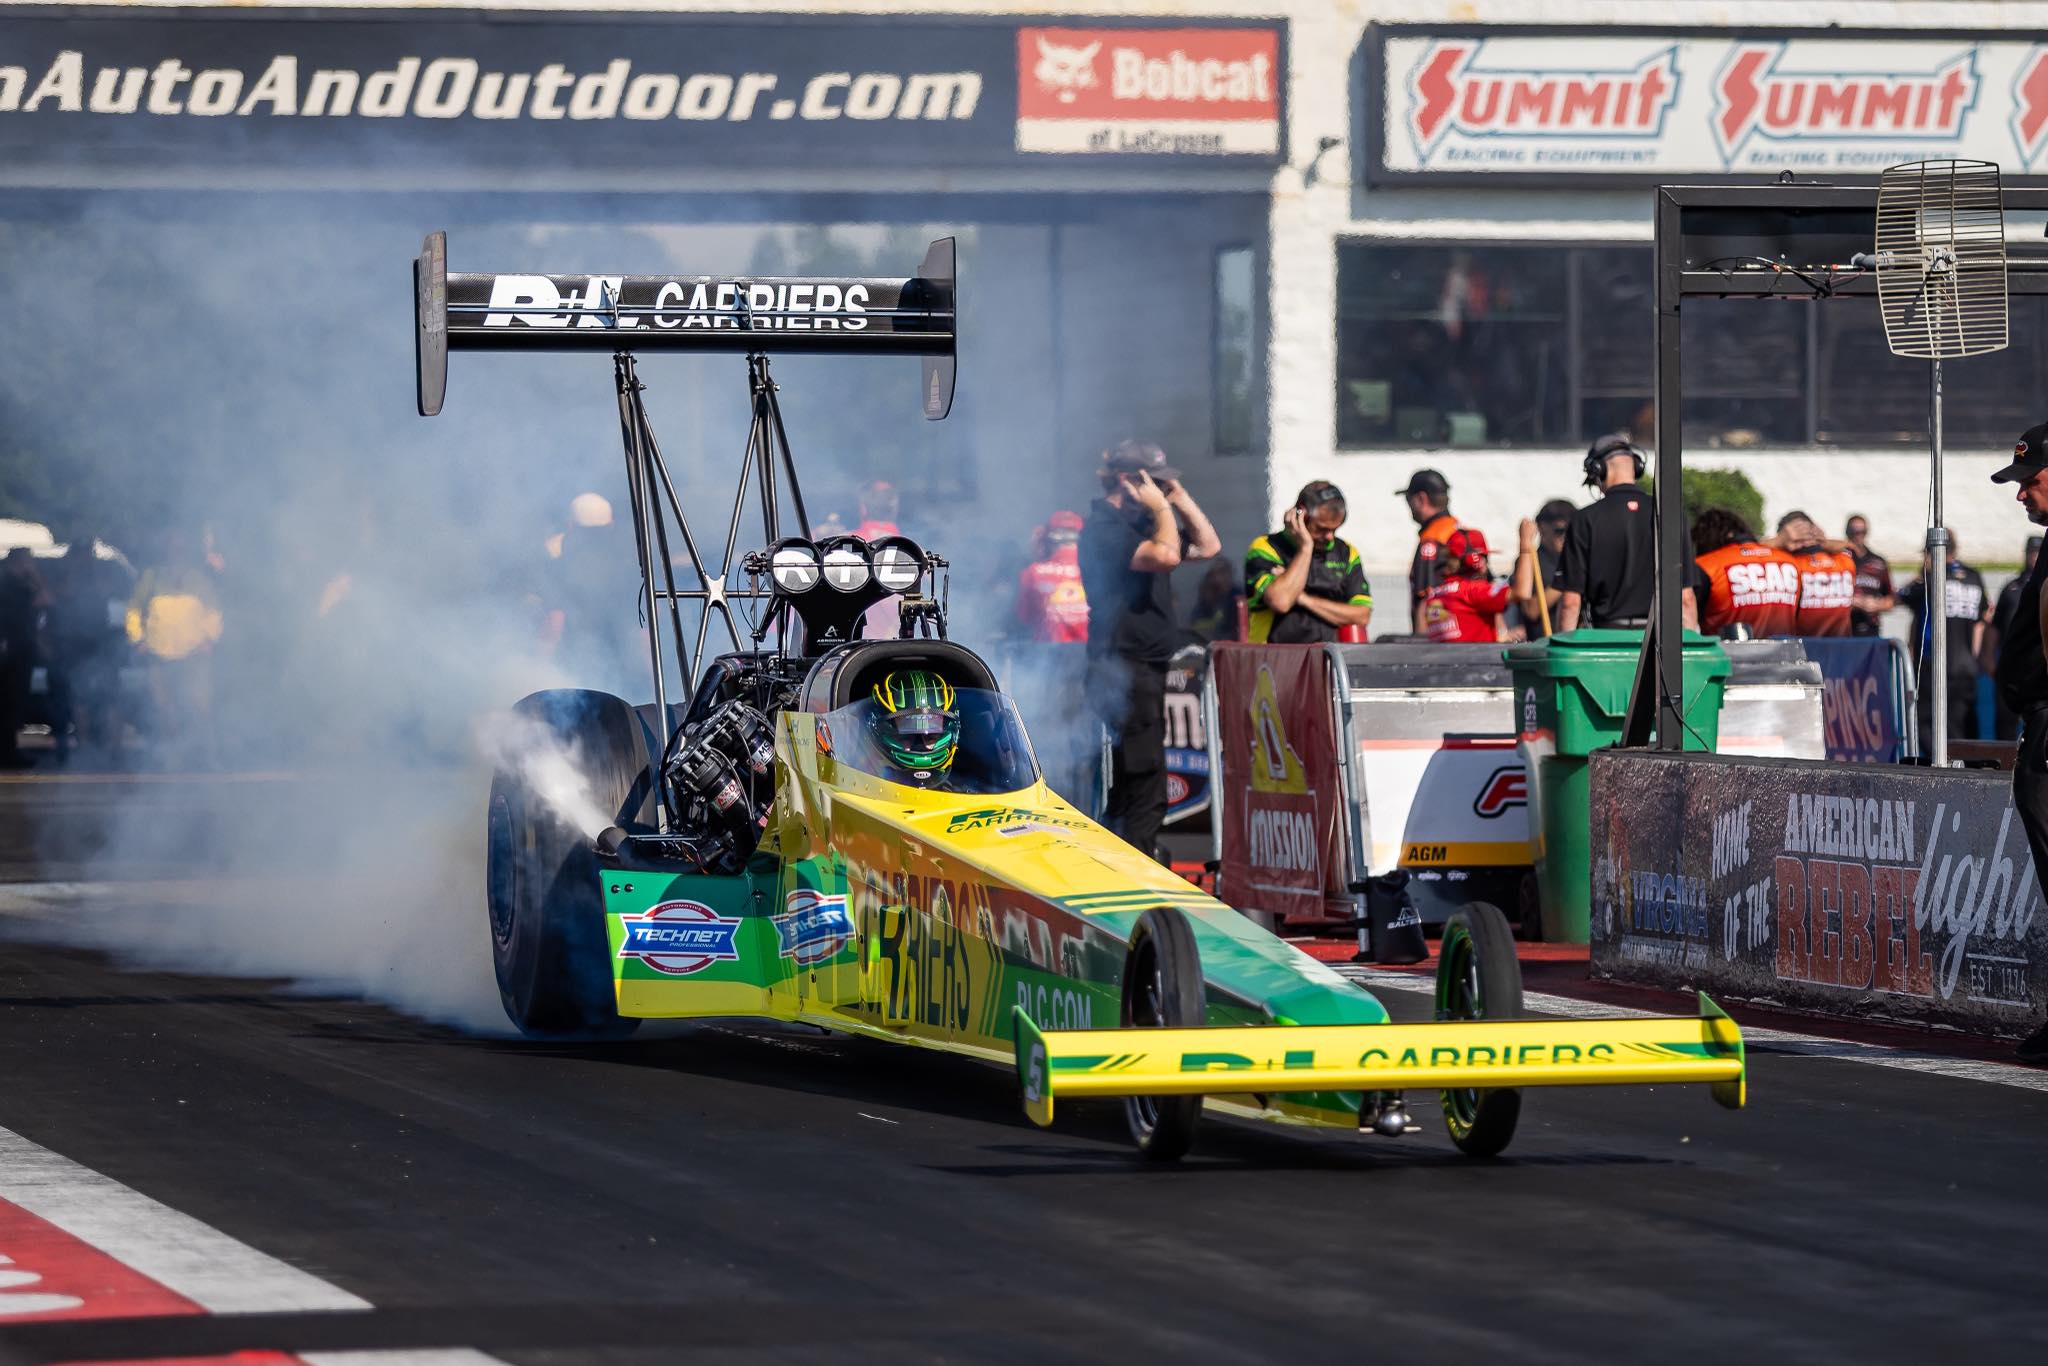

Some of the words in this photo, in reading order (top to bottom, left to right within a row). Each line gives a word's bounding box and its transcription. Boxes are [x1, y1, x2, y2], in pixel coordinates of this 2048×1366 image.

[1112, 48, 1270, 101] Bobcat
[653, 281, 870, 330] CARRIERS
[1728, 562, 1798, 595] SCAG
[1825, 677, 1883, 750] PING
[1408, 846, 1446, 861] AGM
[1712, 800, 1751, 881] HOME
[1785, 793, 1915, 861] AMERICAN
[662, 903, 703, 912] AUTOMOTIVE
[1630, 870, 1709, 938] VIRGINIA
[1724, 891, 1742, 962] OF
[1745, 876, 1771, 952] THE
[1775, 855, 1934, 999] REBEL
[1026, 1042, 1045, 1102] 5
